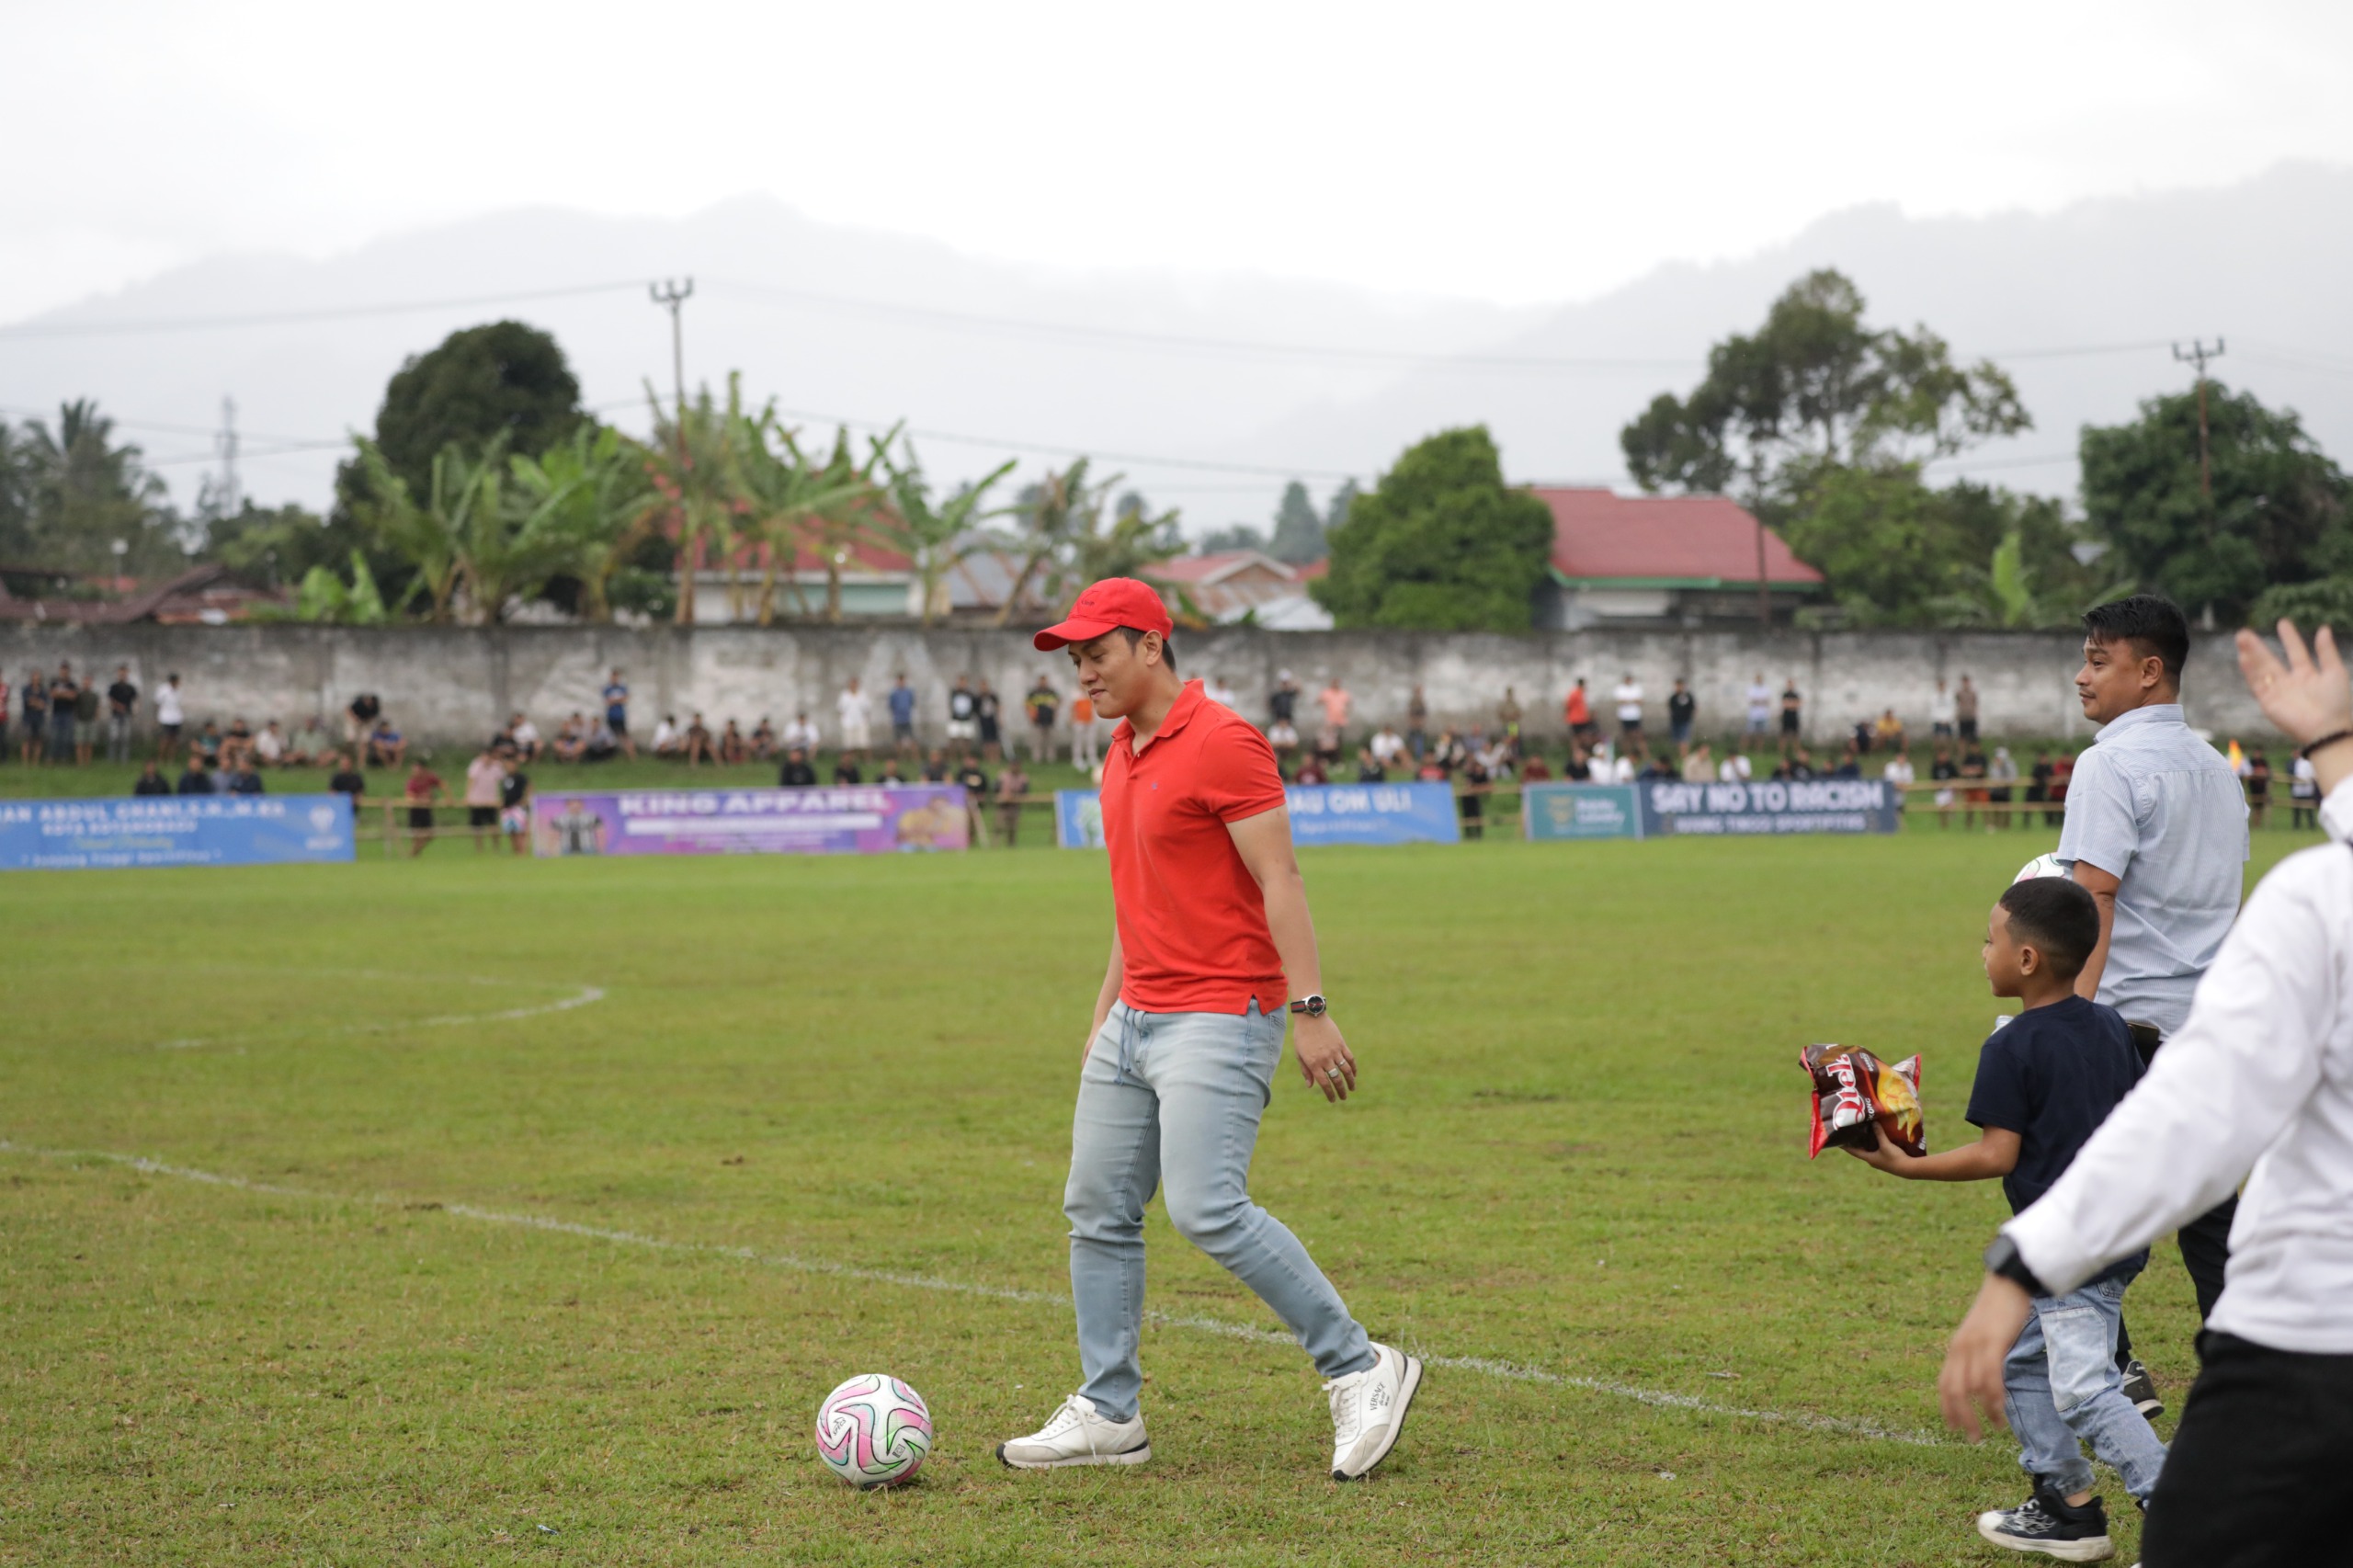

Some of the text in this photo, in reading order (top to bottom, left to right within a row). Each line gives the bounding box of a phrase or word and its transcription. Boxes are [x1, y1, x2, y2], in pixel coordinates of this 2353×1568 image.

[619, 790, 892, 816] KING APPAREL
[1651, 783, 1704, 813] SAY
[1707, 783, 1747, 812] NO
[1748, 782, 1787, 812] TO
[1789, 780, 1885, 810] RACISM
[1370, 1381, 1386, 1411] VERSACE
